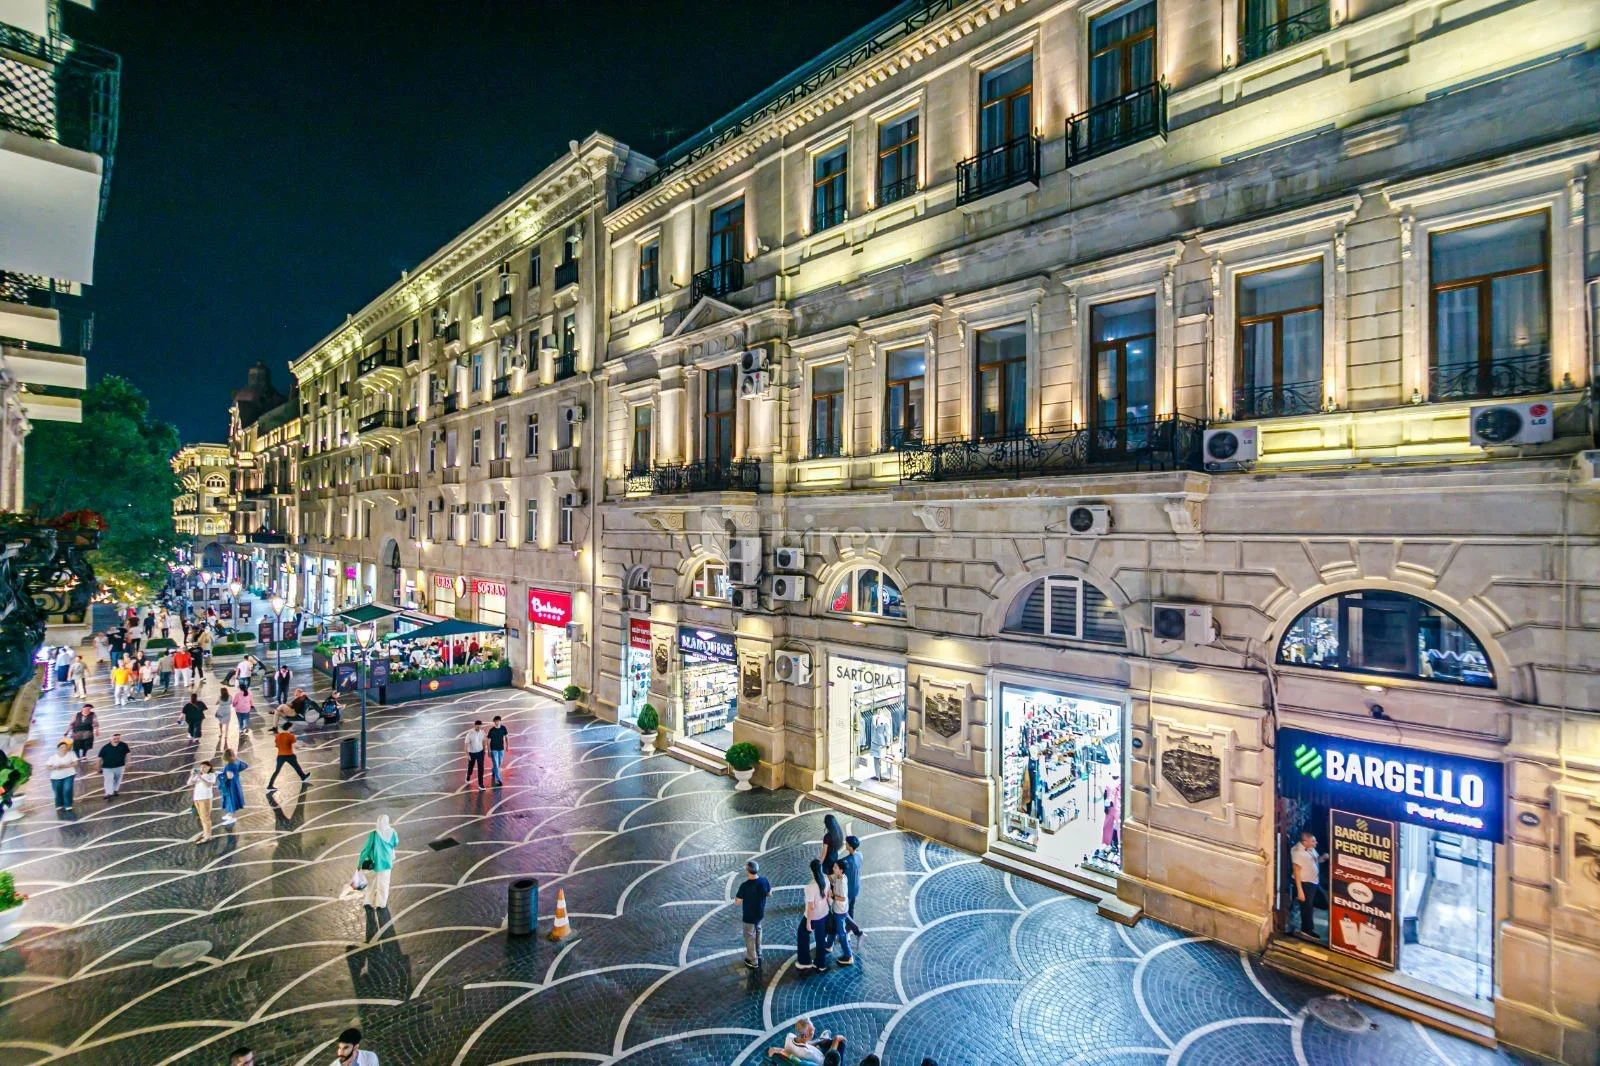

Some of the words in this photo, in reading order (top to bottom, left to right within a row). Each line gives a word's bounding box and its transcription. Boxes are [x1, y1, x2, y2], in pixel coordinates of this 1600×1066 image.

[1531, 418, 1547, 426] LG
[681, 634, 734, 657] MARQUISE
[836, 665, 894, 688] SARTORIA
[1325, 749, 1484, 808] BARGELLO
[1404, 801, 1484, 829] Perfume
[1334, 825, 1391, 849] BARGELLO
[1335, 839, 1391, 863] PERFUME
